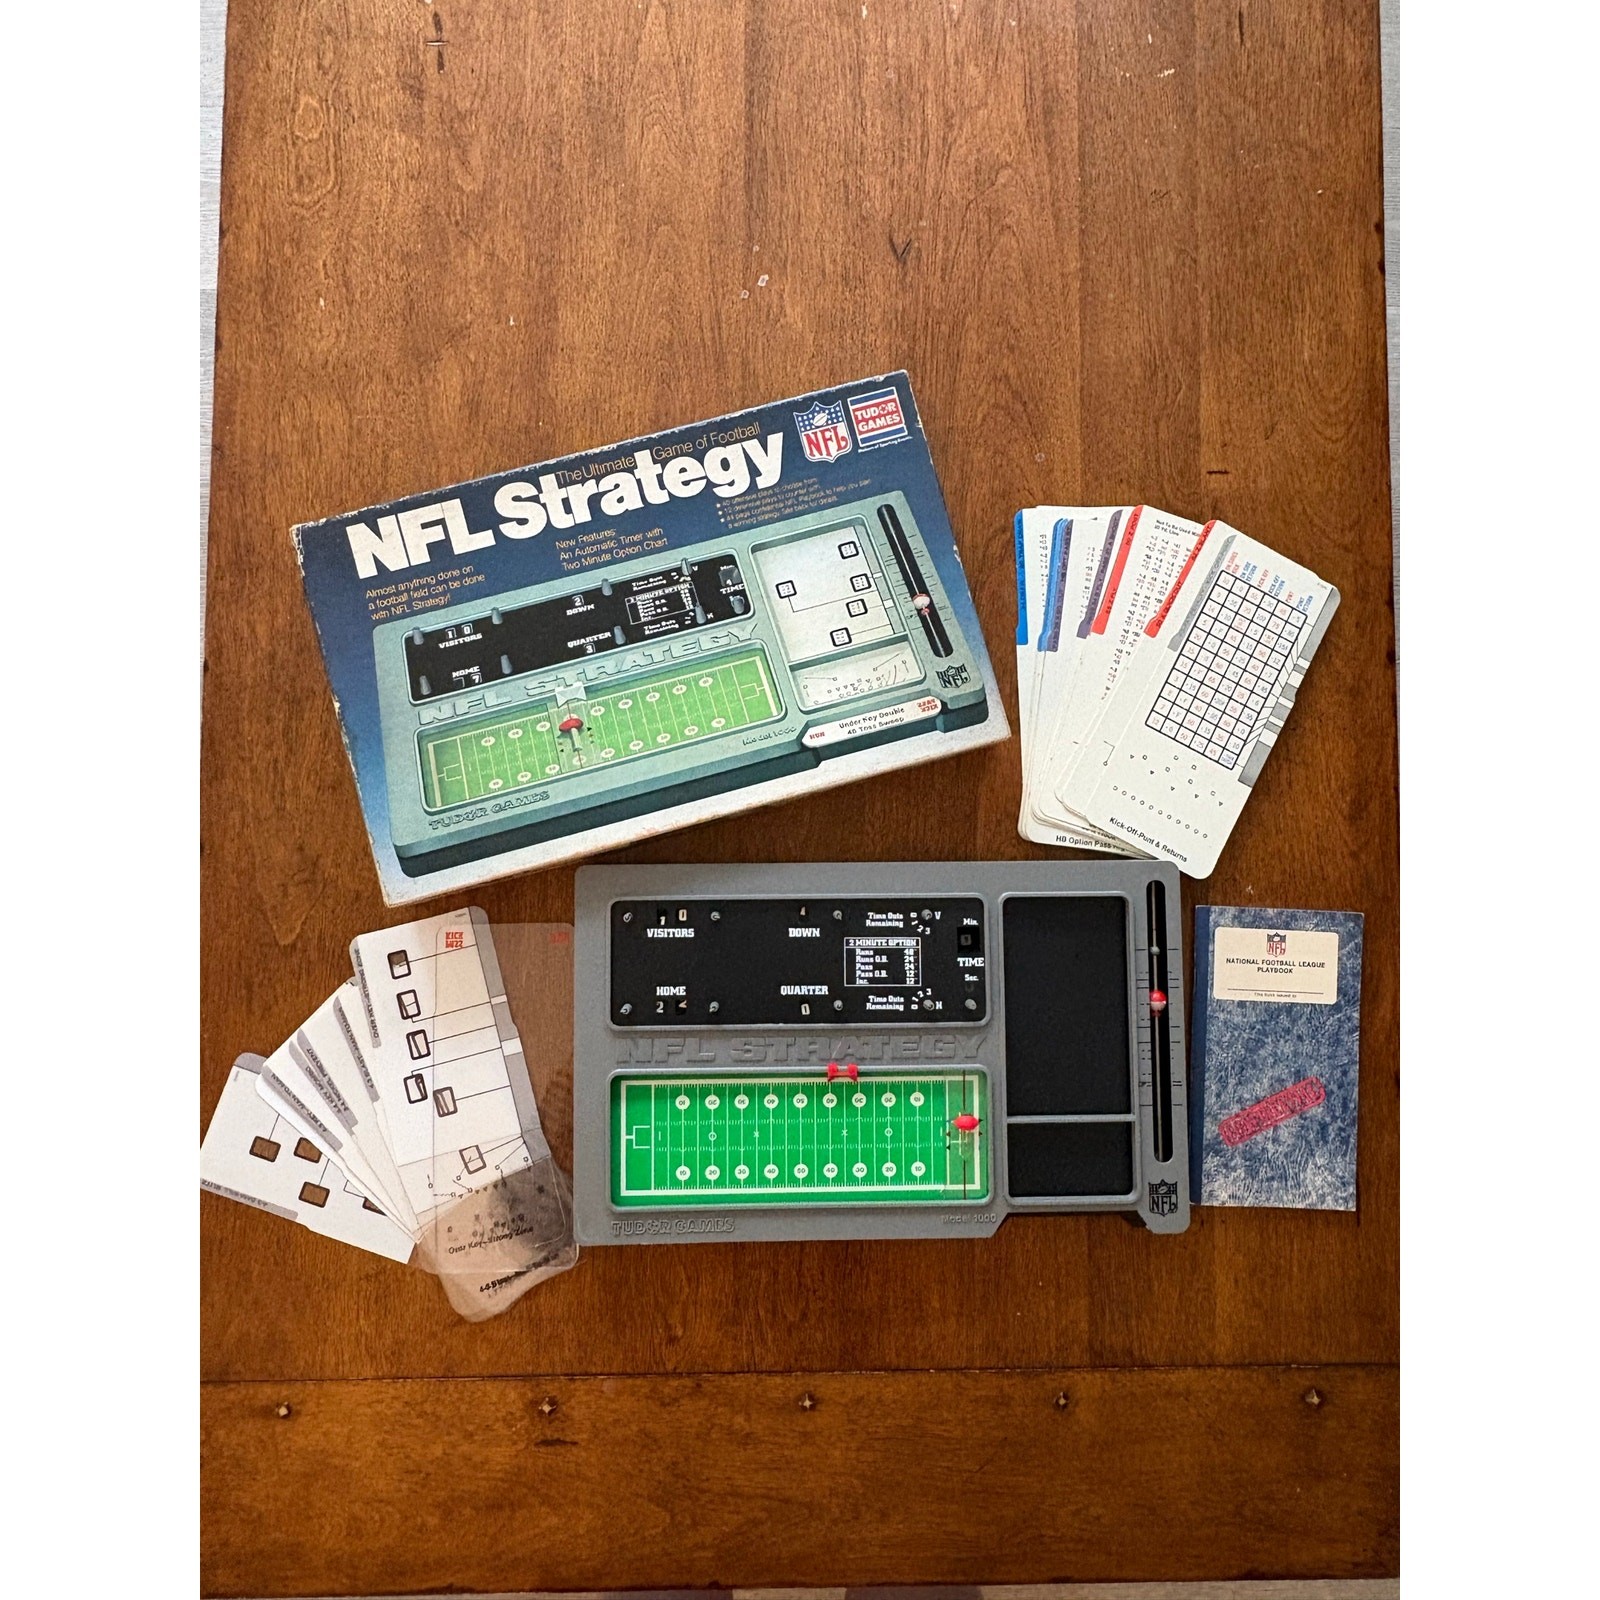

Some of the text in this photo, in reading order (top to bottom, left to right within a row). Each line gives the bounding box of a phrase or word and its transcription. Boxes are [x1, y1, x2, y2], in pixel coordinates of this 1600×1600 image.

[854, 402, 897, 421] TUDOR
[858, 413, 901, 432] GAMES
[803, 425, 849, 458] NFL
[556, 421, 761, 485] The Ultimate Game of Football
[346, 432, 784, 579] NFL Strategy
[555, 539, 576, 550] New
[560, 527, 664, 560] An Automatic Timer with
[561, 537, 668, 571] Two Minute Option Chart
[366, 565, 474, 599] Almost anything done on
[368, 573, 486, 610] a football field can be done
[719, 583, 745, 595] TIME
[371, 609, 390, 620] with
[391, 605, 411, 616] NFL
[566, 603, 596, 616] DOWN
[438, 632, 483, 649] VISITORS
[566, 630, 612, 649] QUARTER
[451, 665, 481, 679] HOME
[417, 689, 513, 726] NFL
[838, 717, 862, 729] Under
[878, 706, 906, 719] Double
[491, 789, 551, 815] GAMES
[1068, 836, 1093, 847] Option
[1109, 816, 1155, 845] Kick-Off-Punt
[1161, 844, 1188, 863] Returns
[678, 909, 687, 921] 0
[867, 912, 887, 920] Time
[887, 912, 904, 920] Outs
[934, 911, 942, 920] V
[865, 919, 904, 928] Remaining
[963, 918, 979, 926] Min.
[445, 931, 464, 940] KICK
[646, 928, 695, 938] VISITORS
[788, 927, 821, 938] DOWN
[916, 924, 931, 935] 2 3
[848, 939, 917, 947] 2 MINUTE OPTION
[1267, 942, 1286, 956] NFL
[957, 957, 985, 967] TIME
[1261, 959, 1296, 967] FOOTBALL
[855, 970, 874, 978] Pass
[964, 973, 980, 982] Sec.
[656, 985, 687, 996] HOME
[780, 985, 829, 996] QUARTER
[917, 987, 932, 998] 2 3
[867, 995, 888, 1003] Time
[888, 995, 905, 1003] Outs
[656, 1001, 664, 1014] 2
[865, 1002, 905, 1012] Remaining
[935, 1001, 943, 1010] H
[616, 1034, 989, 1064] NFL STRATEGY
[1151, 1194, 1177, 1214] NFL
[611, 1219, 672, 1237] TUDOR
[675, 1217, 735, 1235] GAMES
[973, 1212, 998, 1224] 1000
